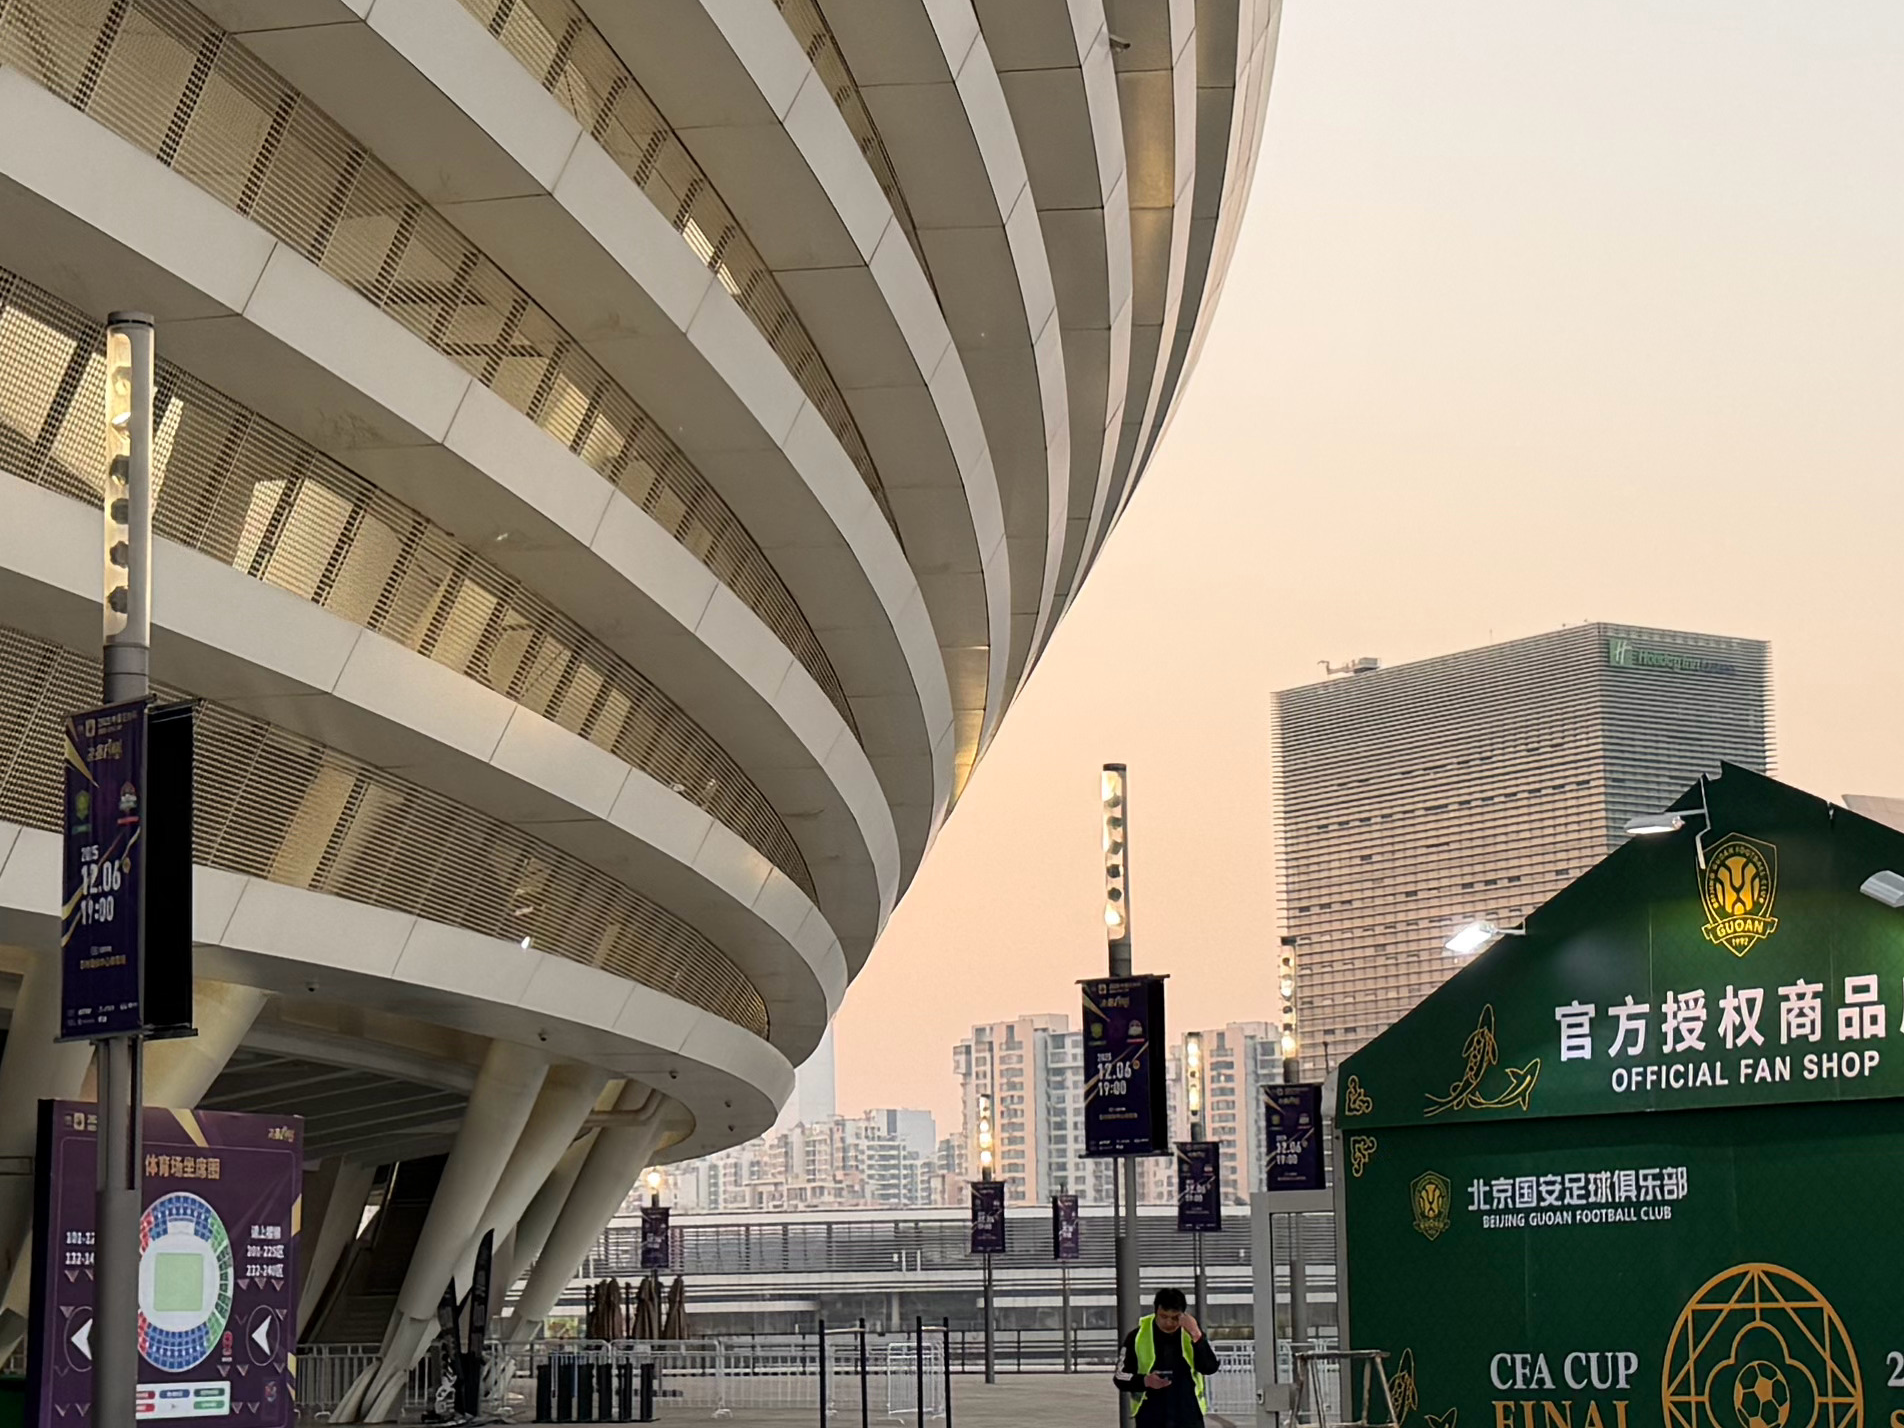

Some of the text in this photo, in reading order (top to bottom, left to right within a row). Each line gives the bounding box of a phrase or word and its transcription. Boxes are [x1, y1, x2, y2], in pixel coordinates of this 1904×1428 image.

[81, 859, 121, 895] 12.06
[80, 895, 114, 925] 19:00
[1716, 919, 1764, 937] GUOAN
[1097, 1061, 1132, 1080] 12.06
[1612, 1051, 1880, 1093] OFFICIAL FAN SHOP
[1098, 1080, 1127, 1097] 19:00
[1468, 1166, 1688, 1211] 北京国安足球俱乐部
[1483, 1206, 1672, 1229] BEIJING GUOAN FOOTBALL CLUB
[1489, 1351, 1639, 1390] CFA CUP
